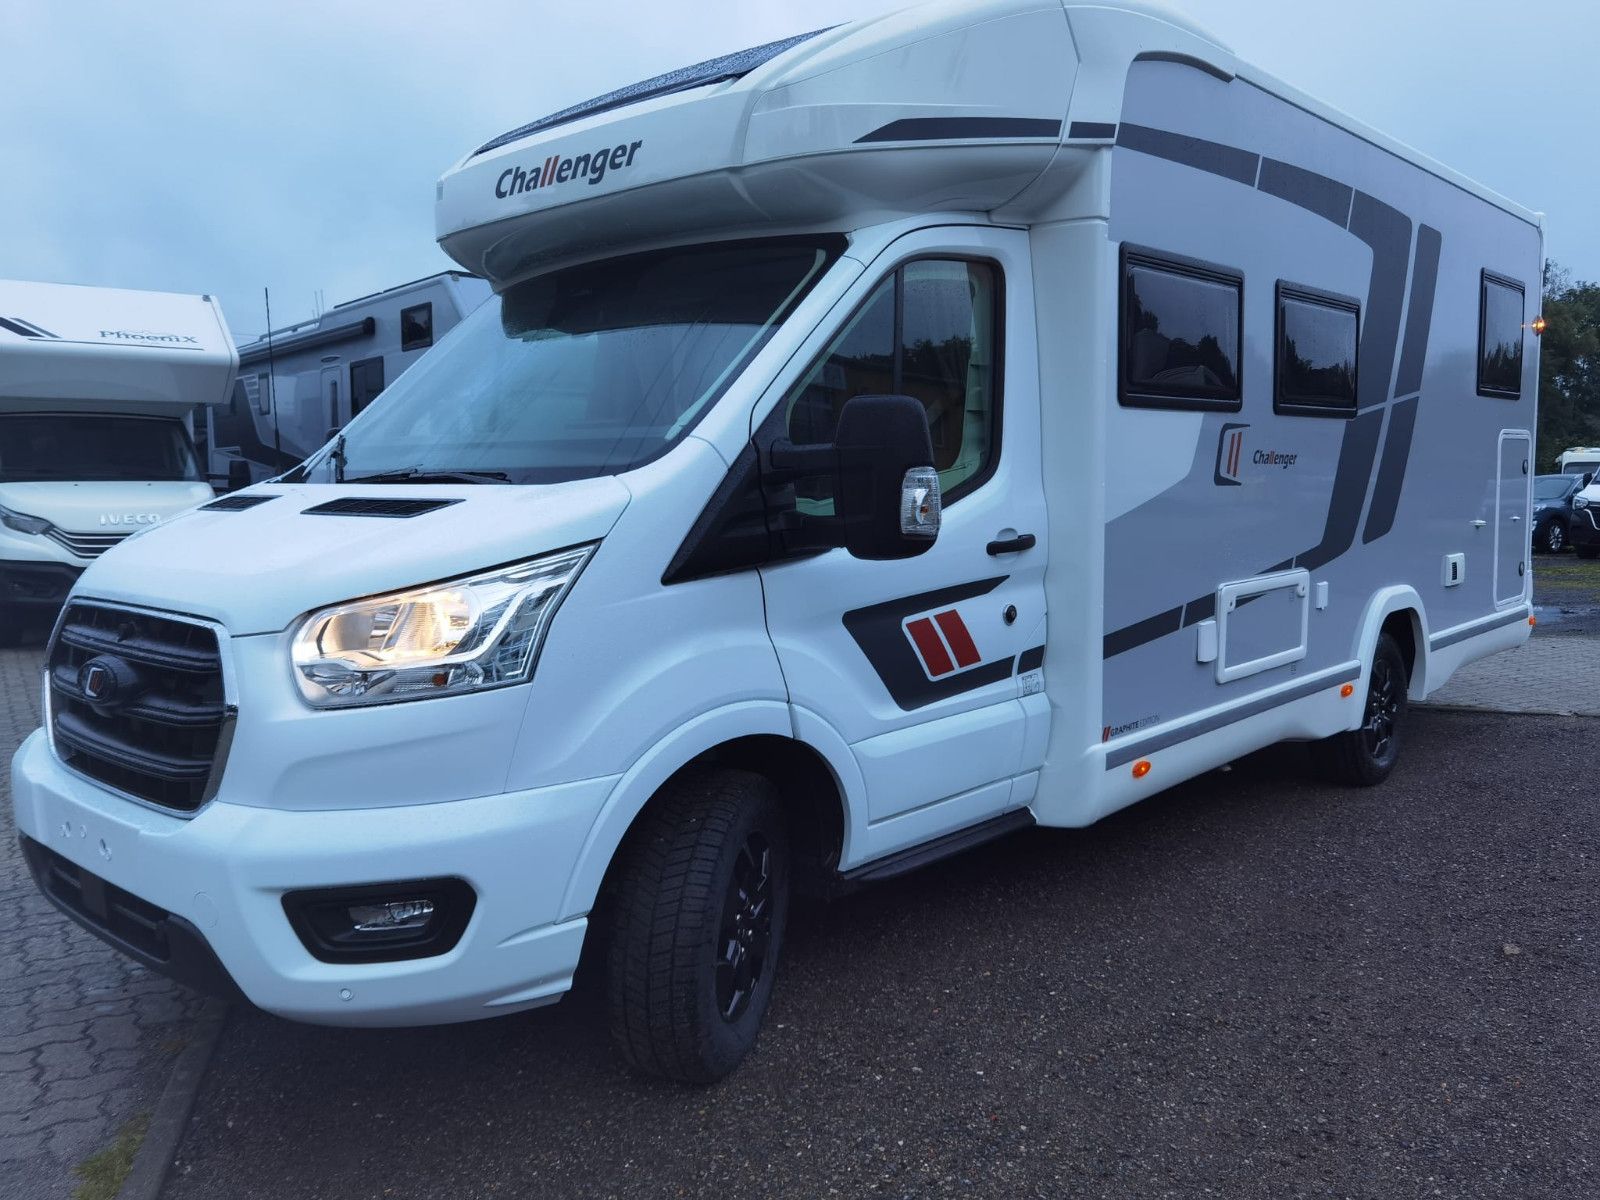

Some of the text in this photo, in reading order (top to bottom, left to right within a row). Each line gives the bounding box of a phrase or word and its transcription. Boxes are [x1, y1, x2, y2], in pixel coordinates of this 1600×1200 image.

[495, 140, 643, 199] Challenger
[99, 330, 199, 343] Phoenix
[1253, 449, 1298, 470] Challenger
[100, 513, 160, 526] IVECO
[1110, 720, 1140, 737] GRAPHITE
